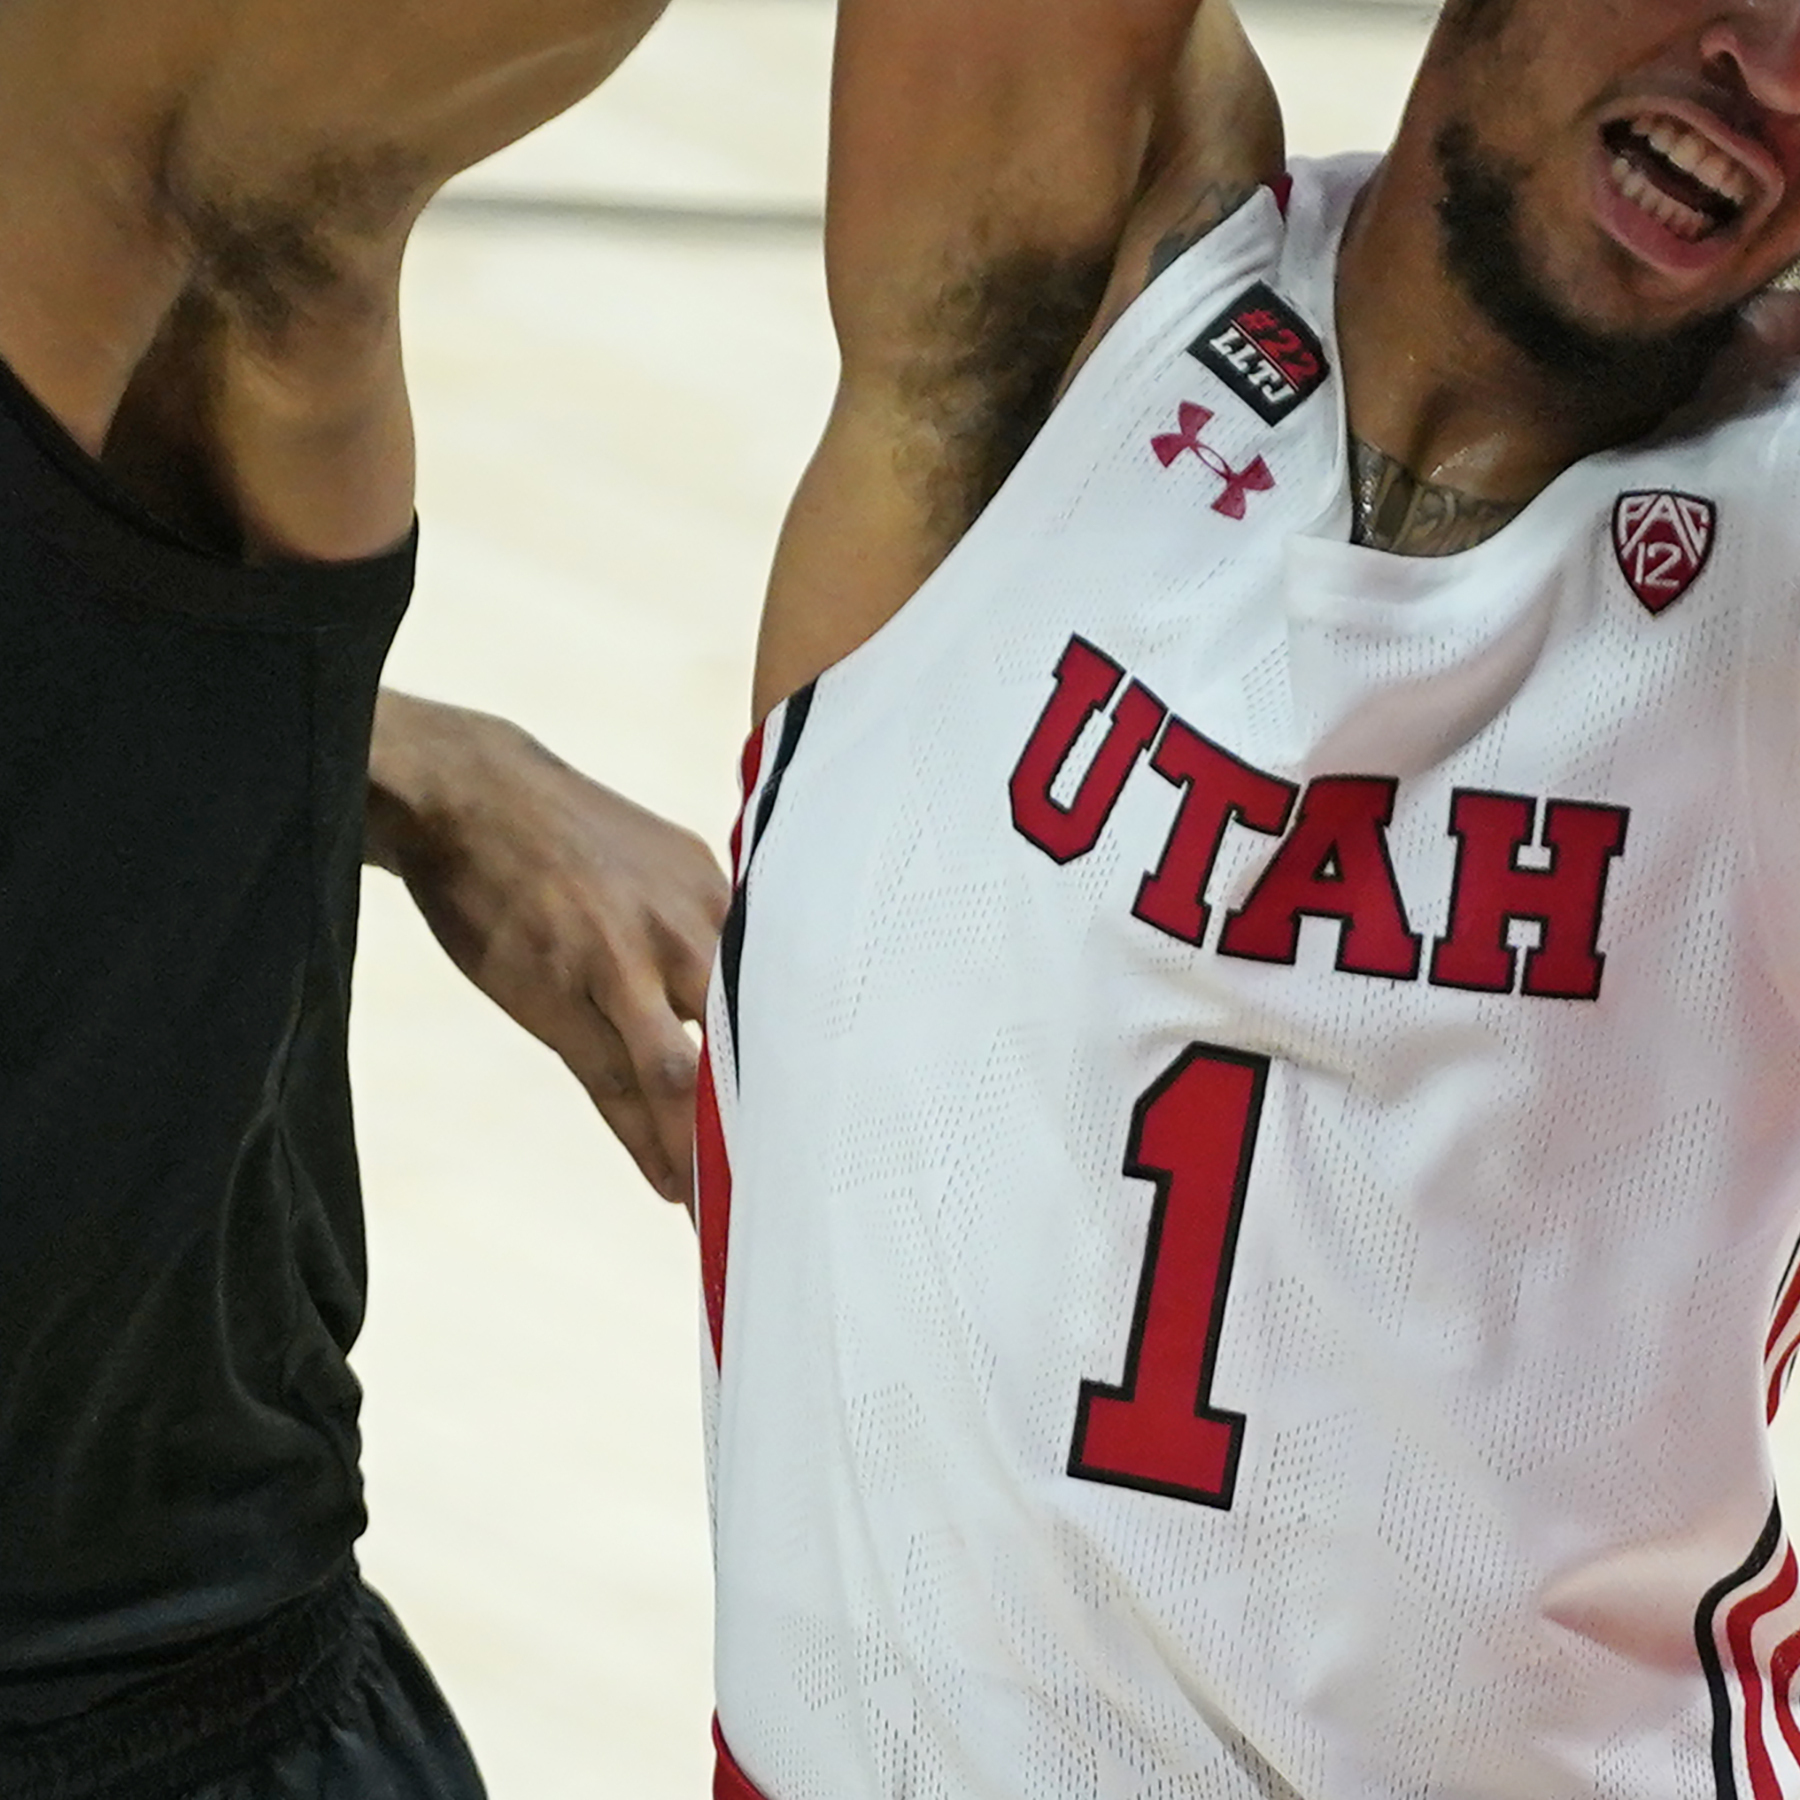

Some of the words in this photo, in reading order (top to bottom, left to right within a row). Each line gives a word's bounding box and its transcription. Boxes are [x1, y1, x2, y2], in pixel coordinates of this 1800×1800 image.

[1235, 309, 1319, 382] #22
[1617, 493, 1710, 568] PAC
[1634, 541, 1682, 587] 12
[1008, 632, 1631, 1002] UTAH
[1066, 1041, 1271, 1511] 1
